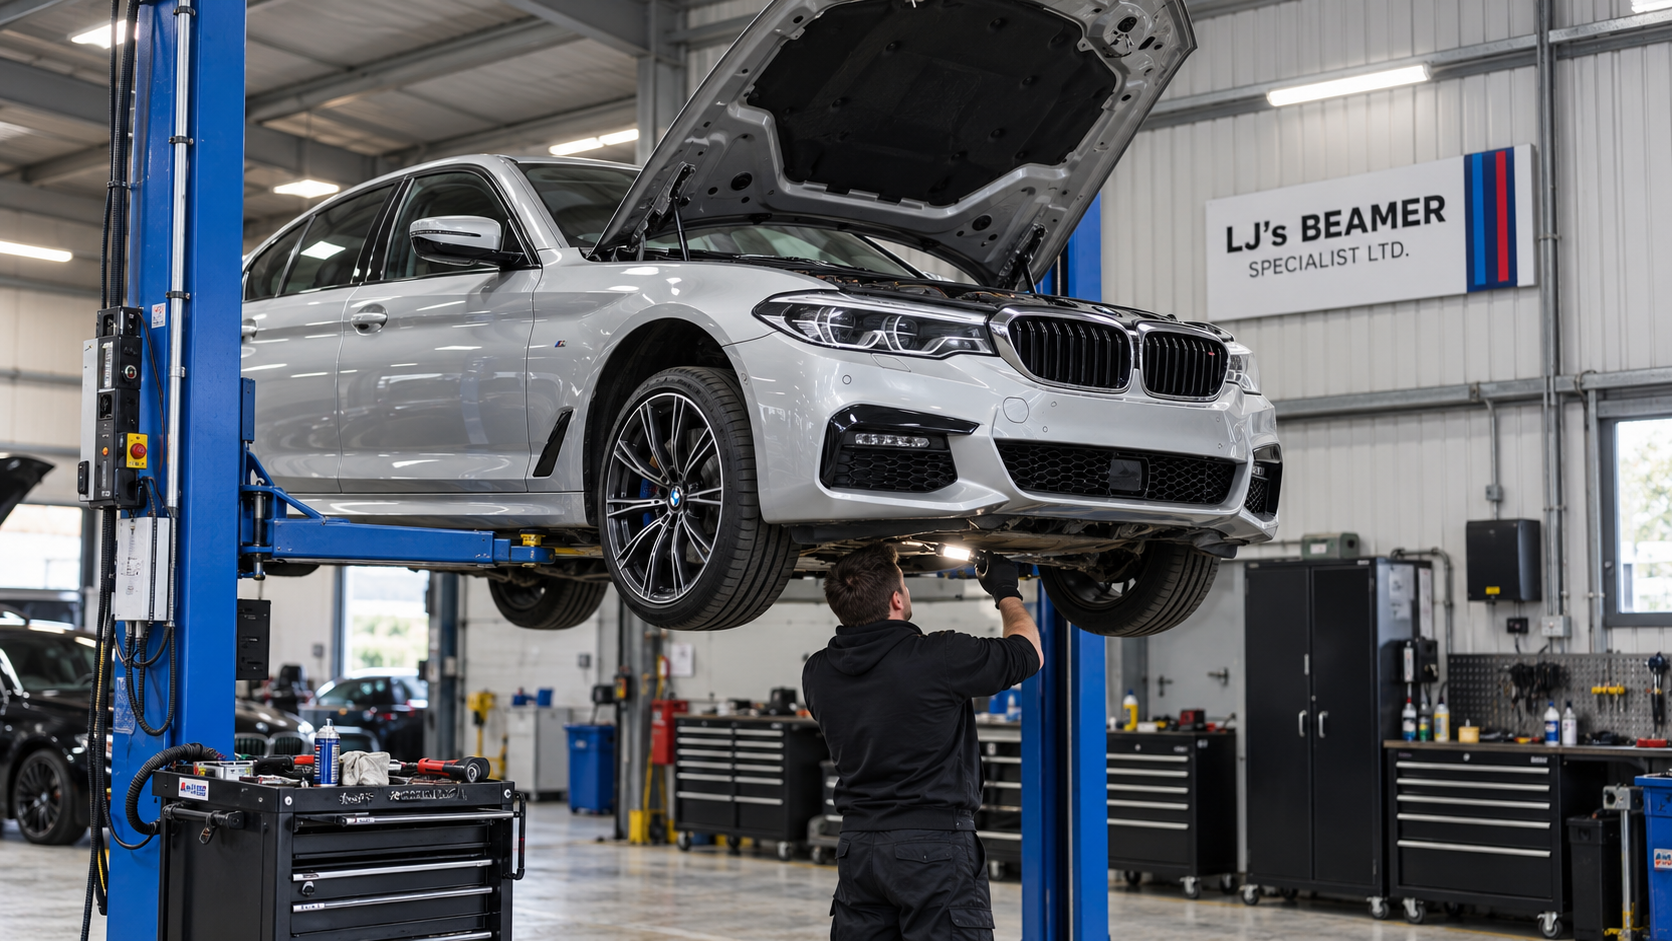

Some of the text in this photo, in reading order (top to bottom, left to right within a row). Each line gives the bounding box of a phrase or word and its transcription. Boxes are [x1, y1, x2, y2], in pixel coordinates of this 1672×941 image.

[1226, 194, 1447, 254] LJ's BEAMER
[1248, 241, 1410, 278] SPECIALIST LTD.
